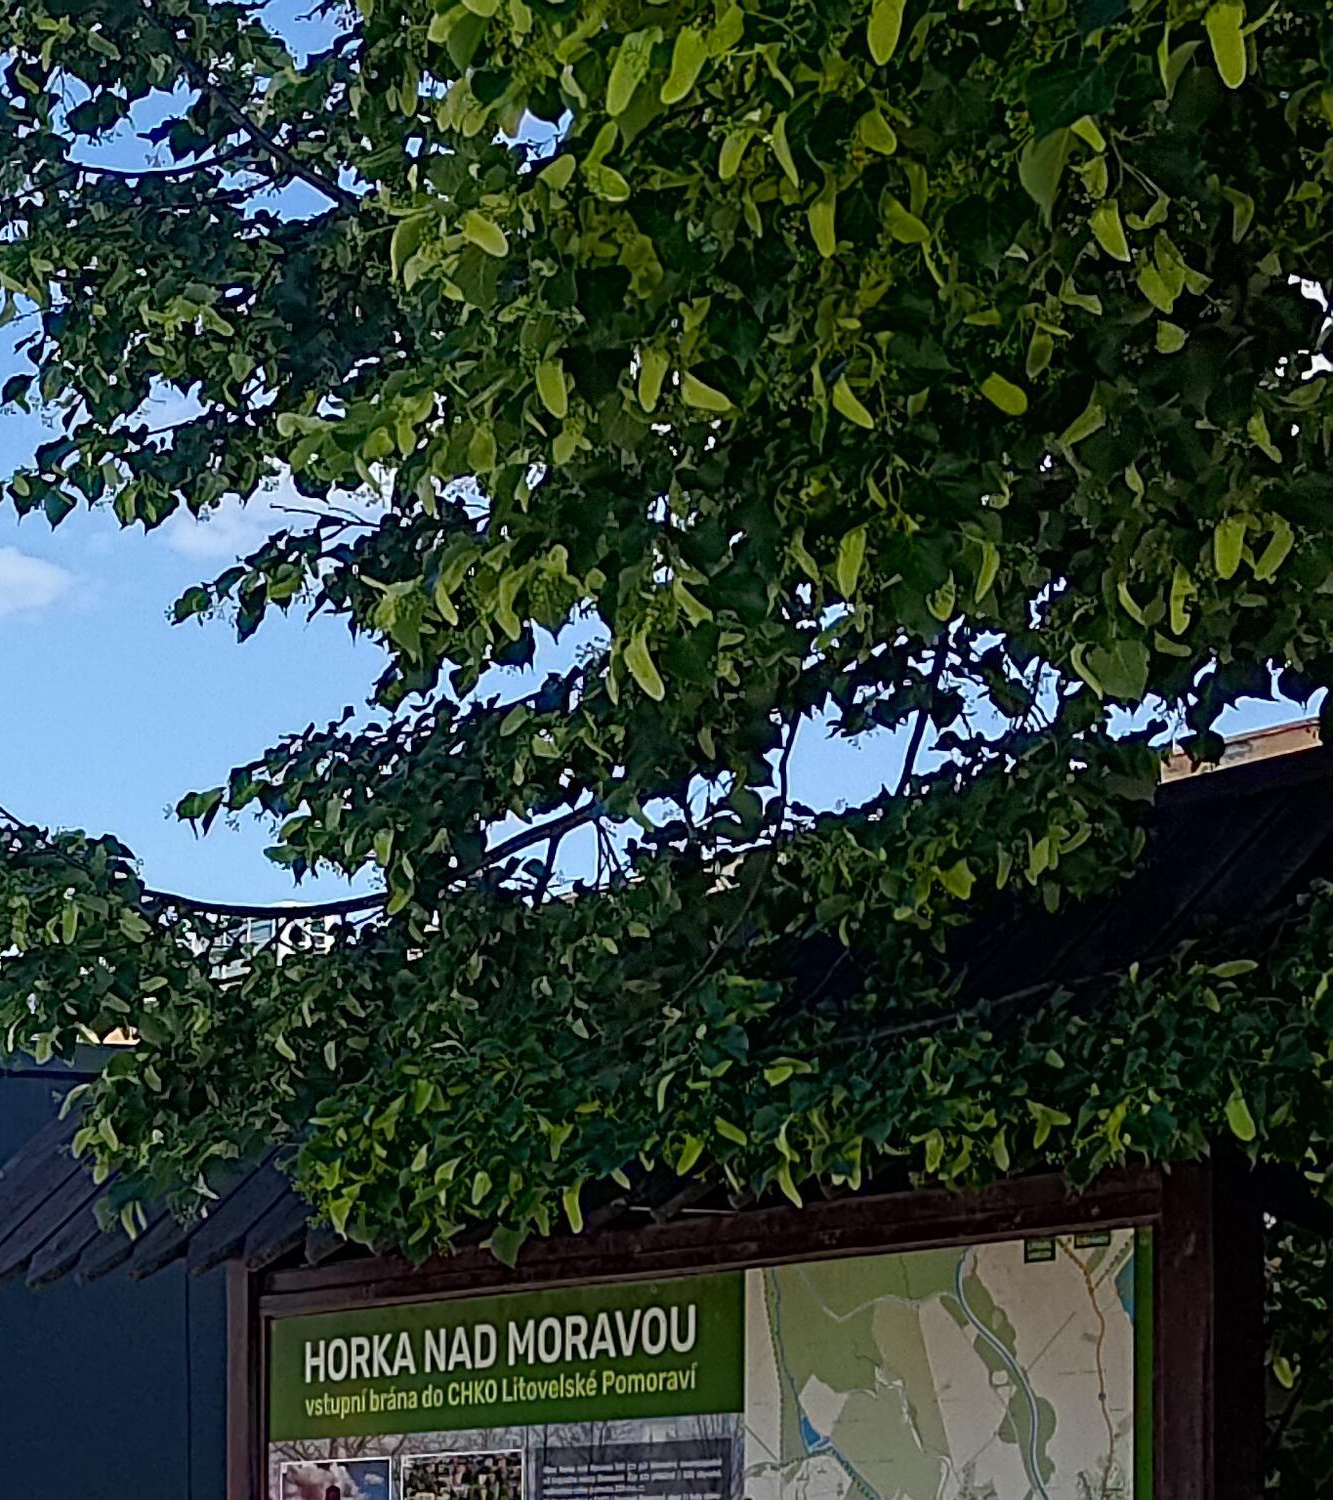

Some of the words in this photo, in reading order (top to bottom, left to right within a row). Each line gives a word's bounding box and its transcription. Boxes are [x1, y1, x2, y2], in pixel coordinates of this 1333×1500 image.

[304, 1331, 416, 1384] HORKA
[424, 1323, 497, 1373] NAD
[507, 1304, 697, 1367] MORAVOU
[305, 1387, 367, 1420] vstupní
[369, 1385, 418, 1413] brána
[422, 1384, 444, 1408] do
[447, 1378, 498, 1406] CHKO
[502, 1368, 598, 1403] Litovelské
[602, 1361, 699, 1396] Pomoraví
